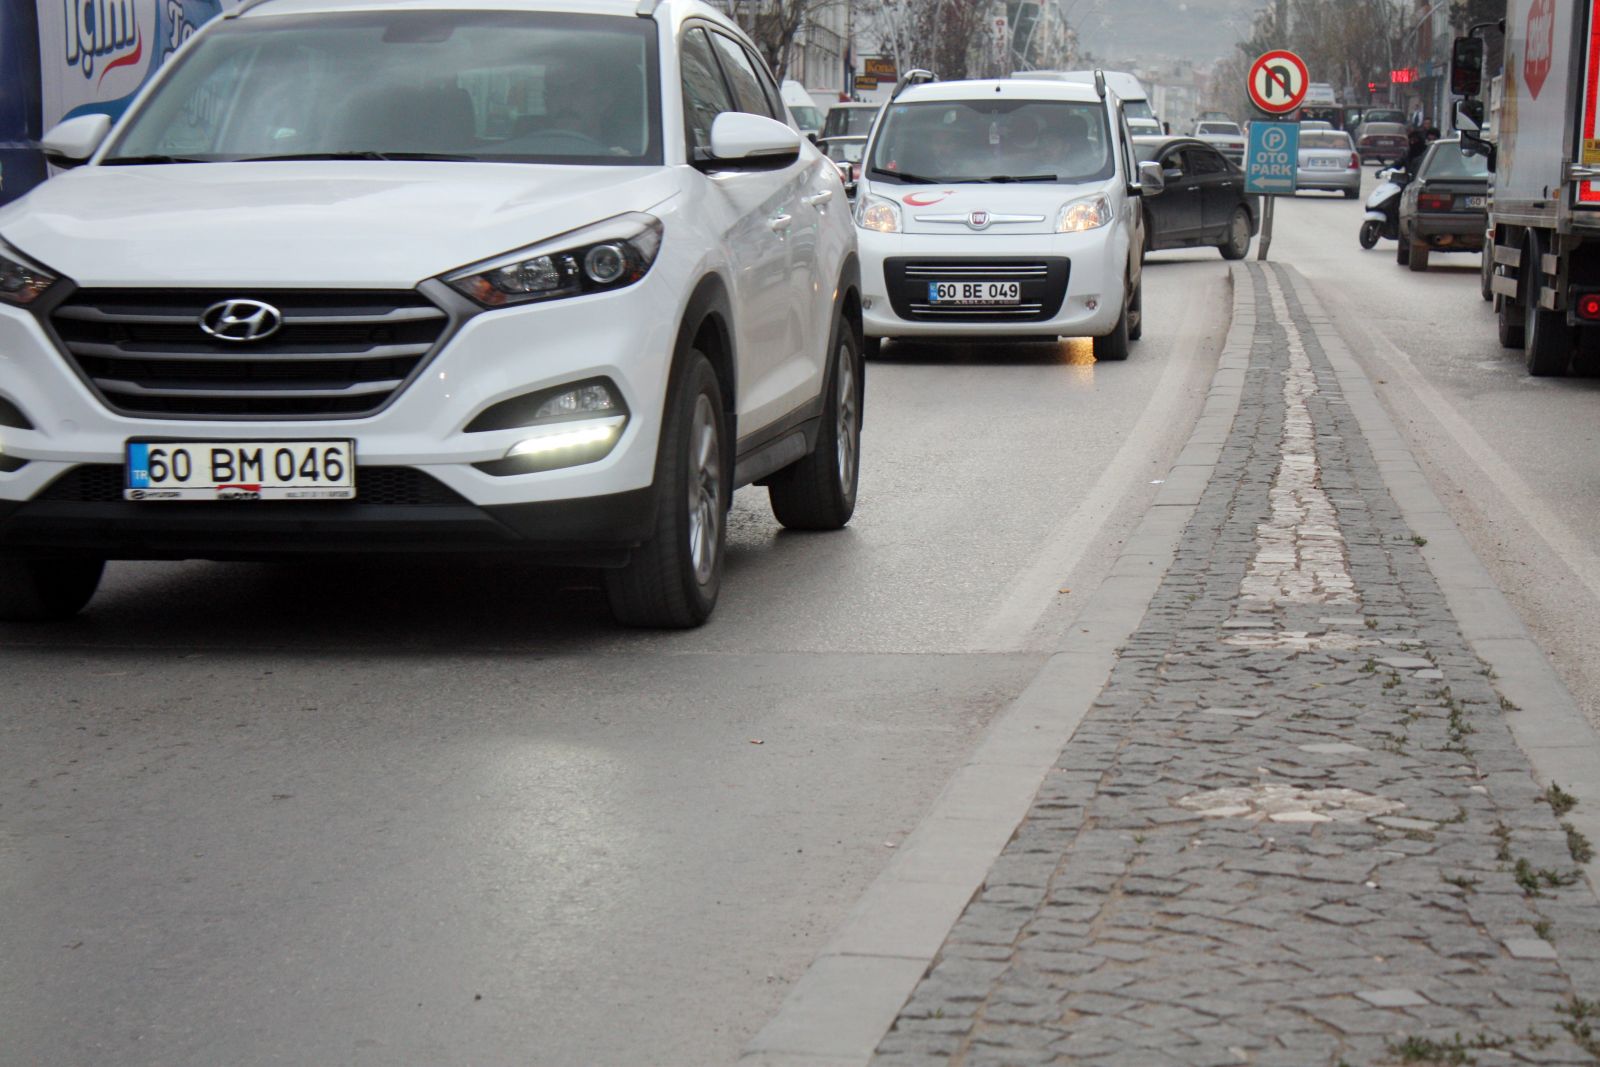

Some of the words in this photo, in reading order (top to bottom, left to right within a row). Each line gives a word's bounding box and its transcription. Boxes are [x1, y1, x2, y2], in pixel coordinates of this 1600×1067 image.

[1269, 133, 1281, 147] P
[1256, 151, 1288, 164] OTO
[1251, 163, 1292, 176] PARK
[937, 284, 956, 299] 60
[963, 284, 982, 299] BE
[989, 284, 1018, 299] 049
[149, 448, 191, 482] 60
[211, 448, 264, 482] BM
[275, 447, 344, 482] 046
[134, 469, 148, 480] TR
